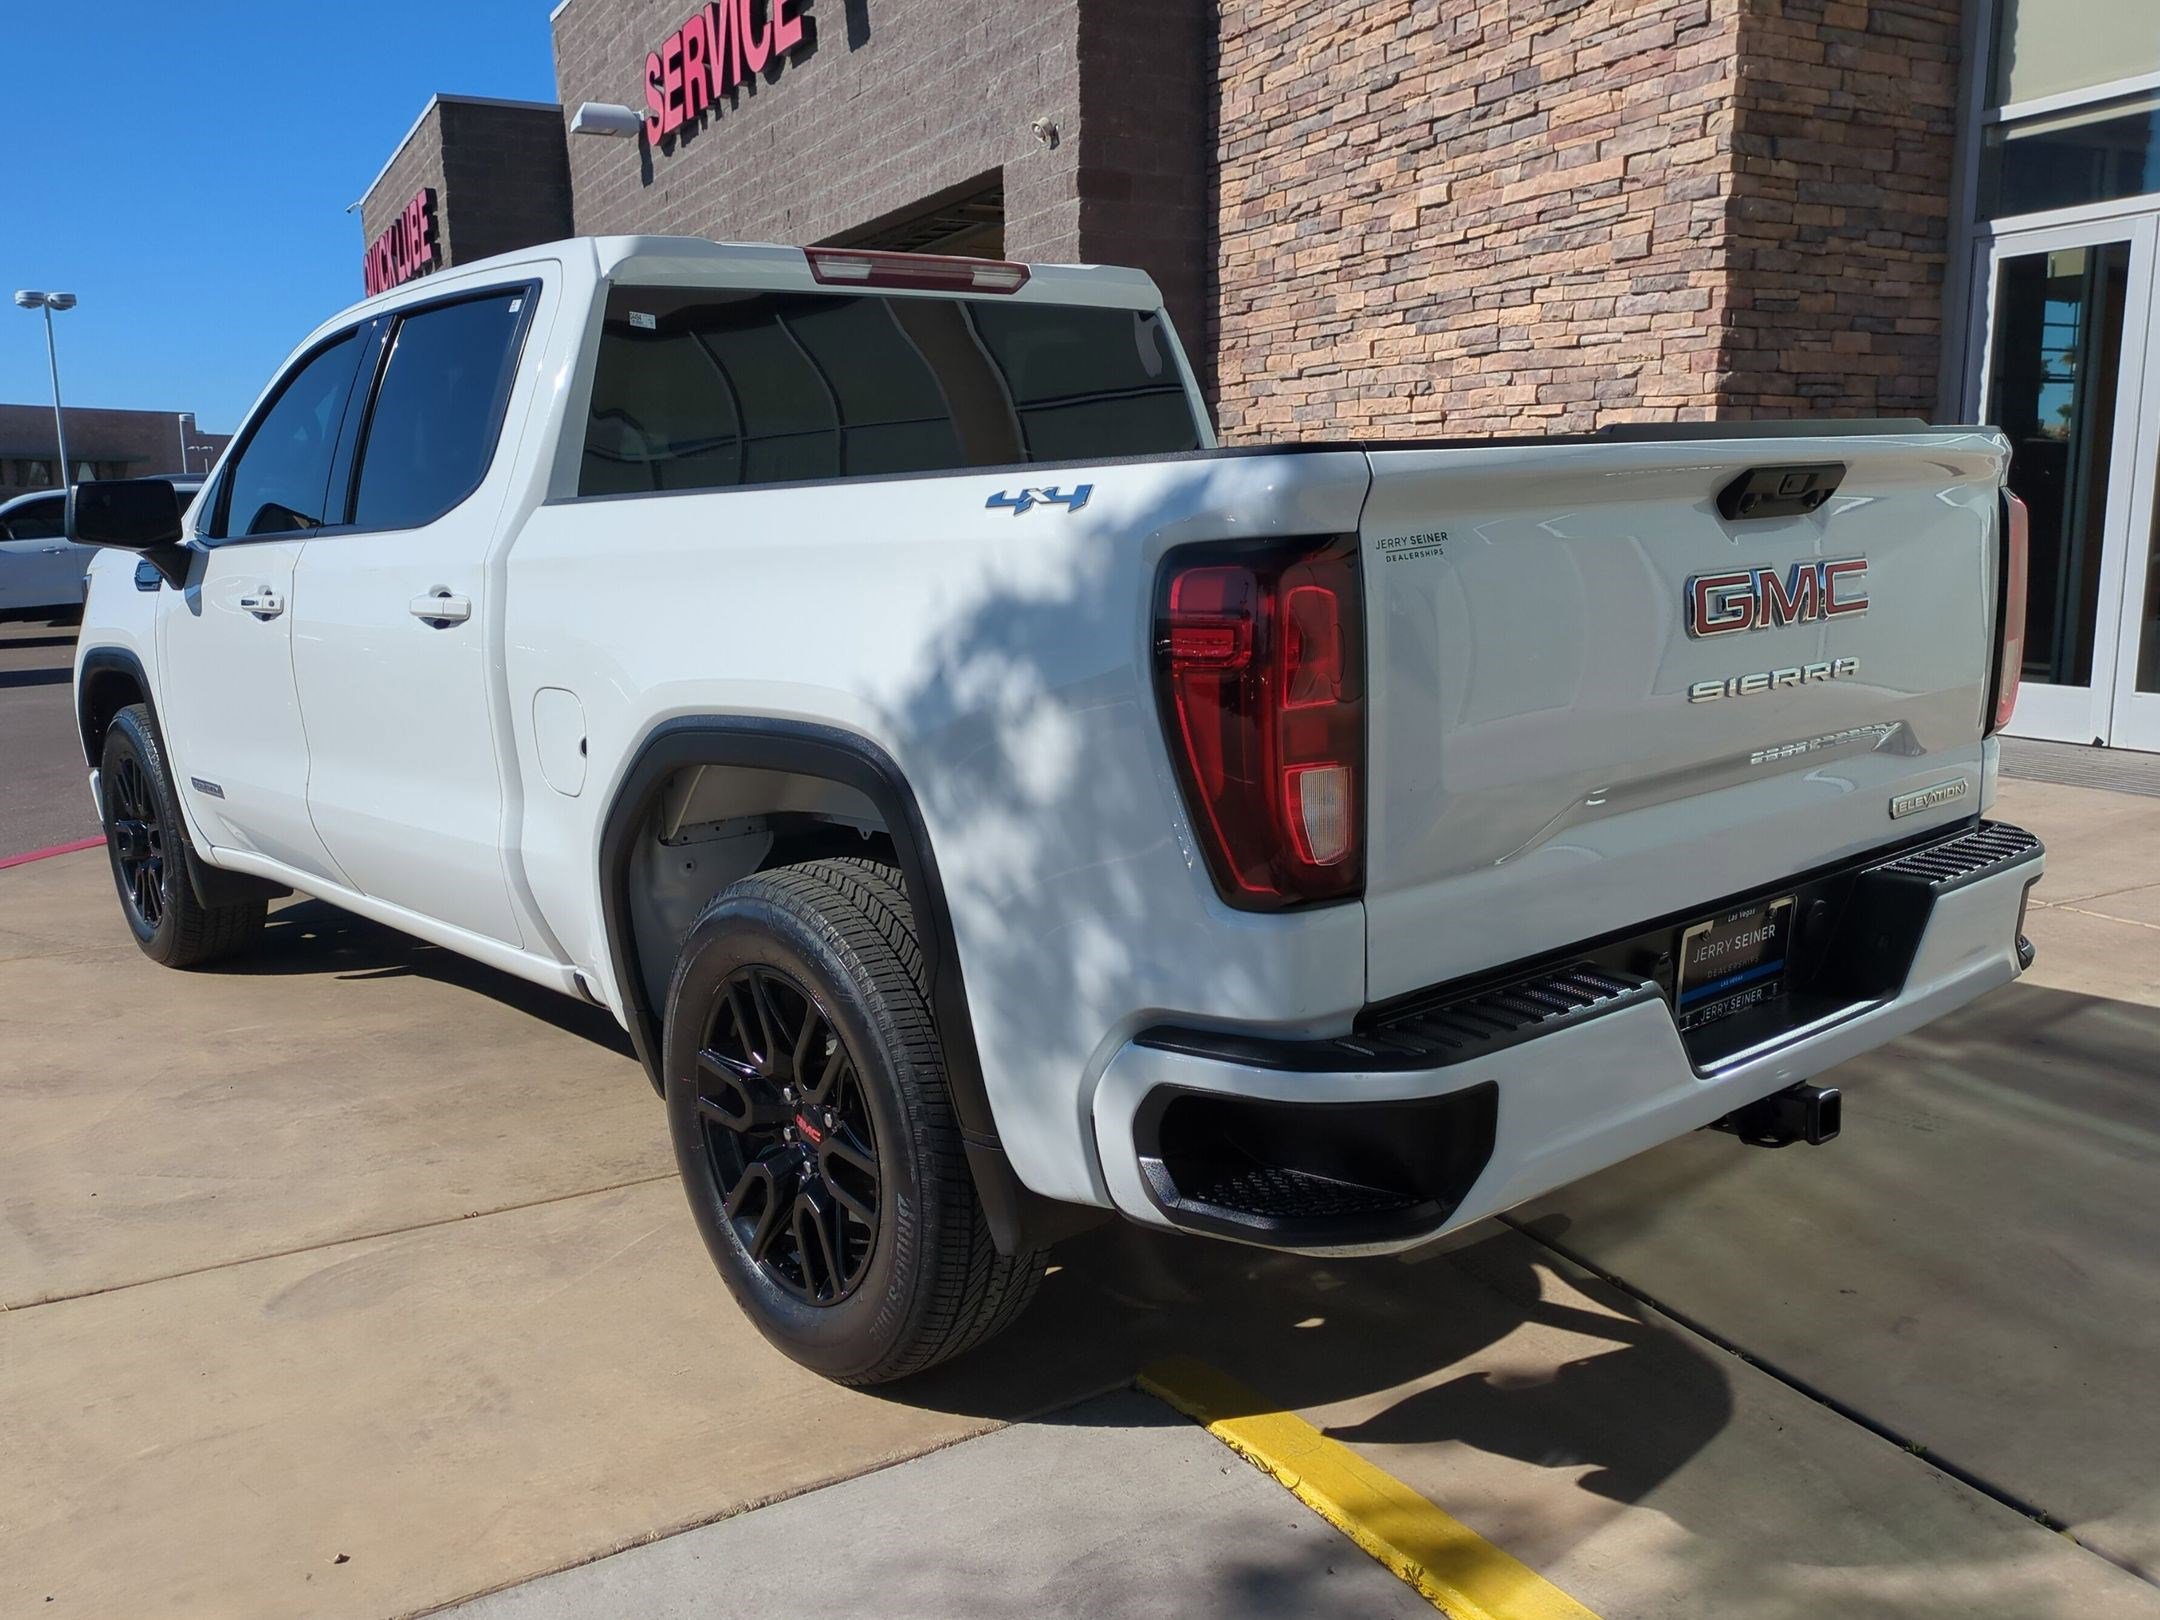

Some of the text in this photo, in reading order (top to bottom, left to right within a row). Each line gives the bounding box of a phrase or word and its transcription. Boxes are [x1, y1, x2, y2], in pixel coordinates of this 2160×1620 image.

[645, 0, 803, 145] SERVICE
[395, 188, 432, 283] LUBE
[1375, 531, 1448, 550] JERRY SEINER
[1385, 548, 1444, 563] DEALERSHIPS
[1685, 557, 1871, 639] GMC
[1688, 656, 1860, 703] SIERRA
[1898, 784, 1965, 813] ELEVATION
[1727, 908, 1756, 923] Las Vegas
[1693, 924, 1776, 963] JERRY SEINER
[1701, 988, 1763, 1022] JERRY SEINER
